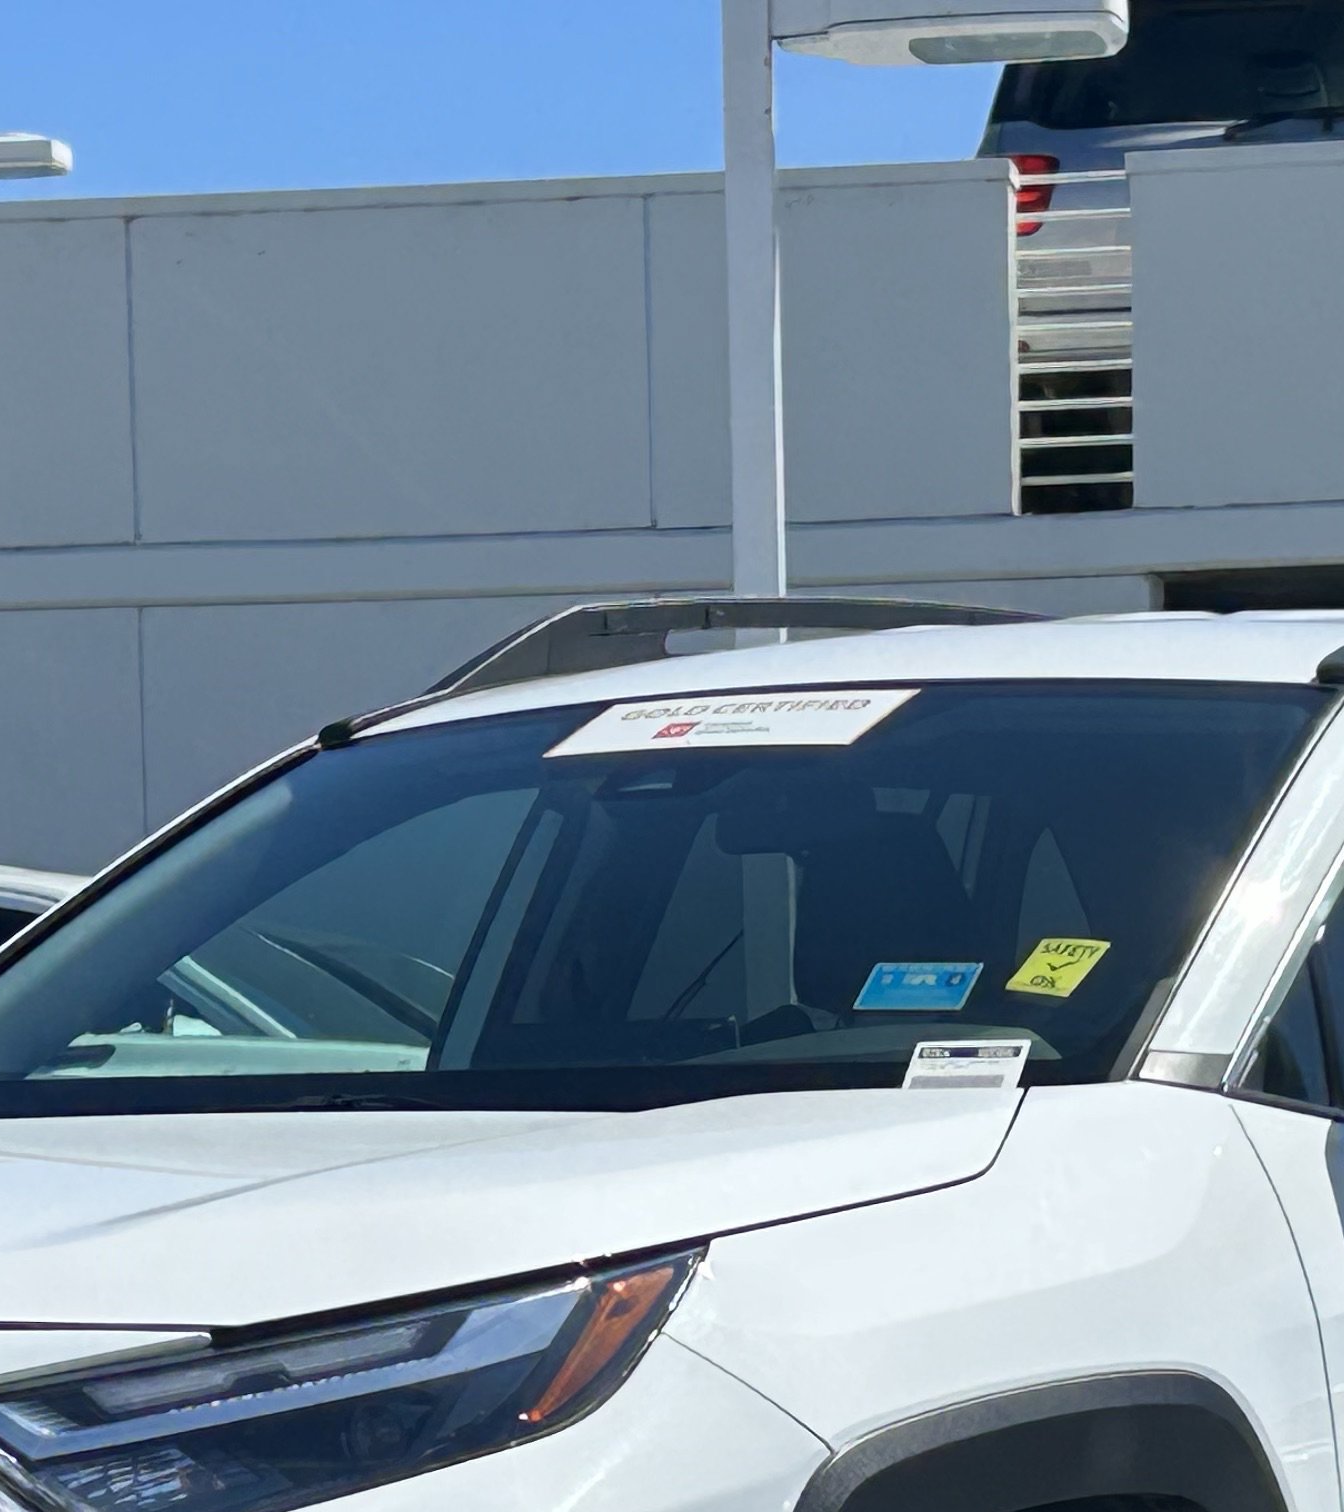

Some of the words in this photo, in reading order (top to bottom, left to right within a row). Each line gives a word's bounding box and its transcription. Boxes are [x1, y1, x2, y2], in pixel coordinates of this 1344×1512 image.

[621, 704, 709, 721] GOLD
[712, 699, 871, 717] CERTIFIED
[1041, 941, 1101, 958] SAFETY
